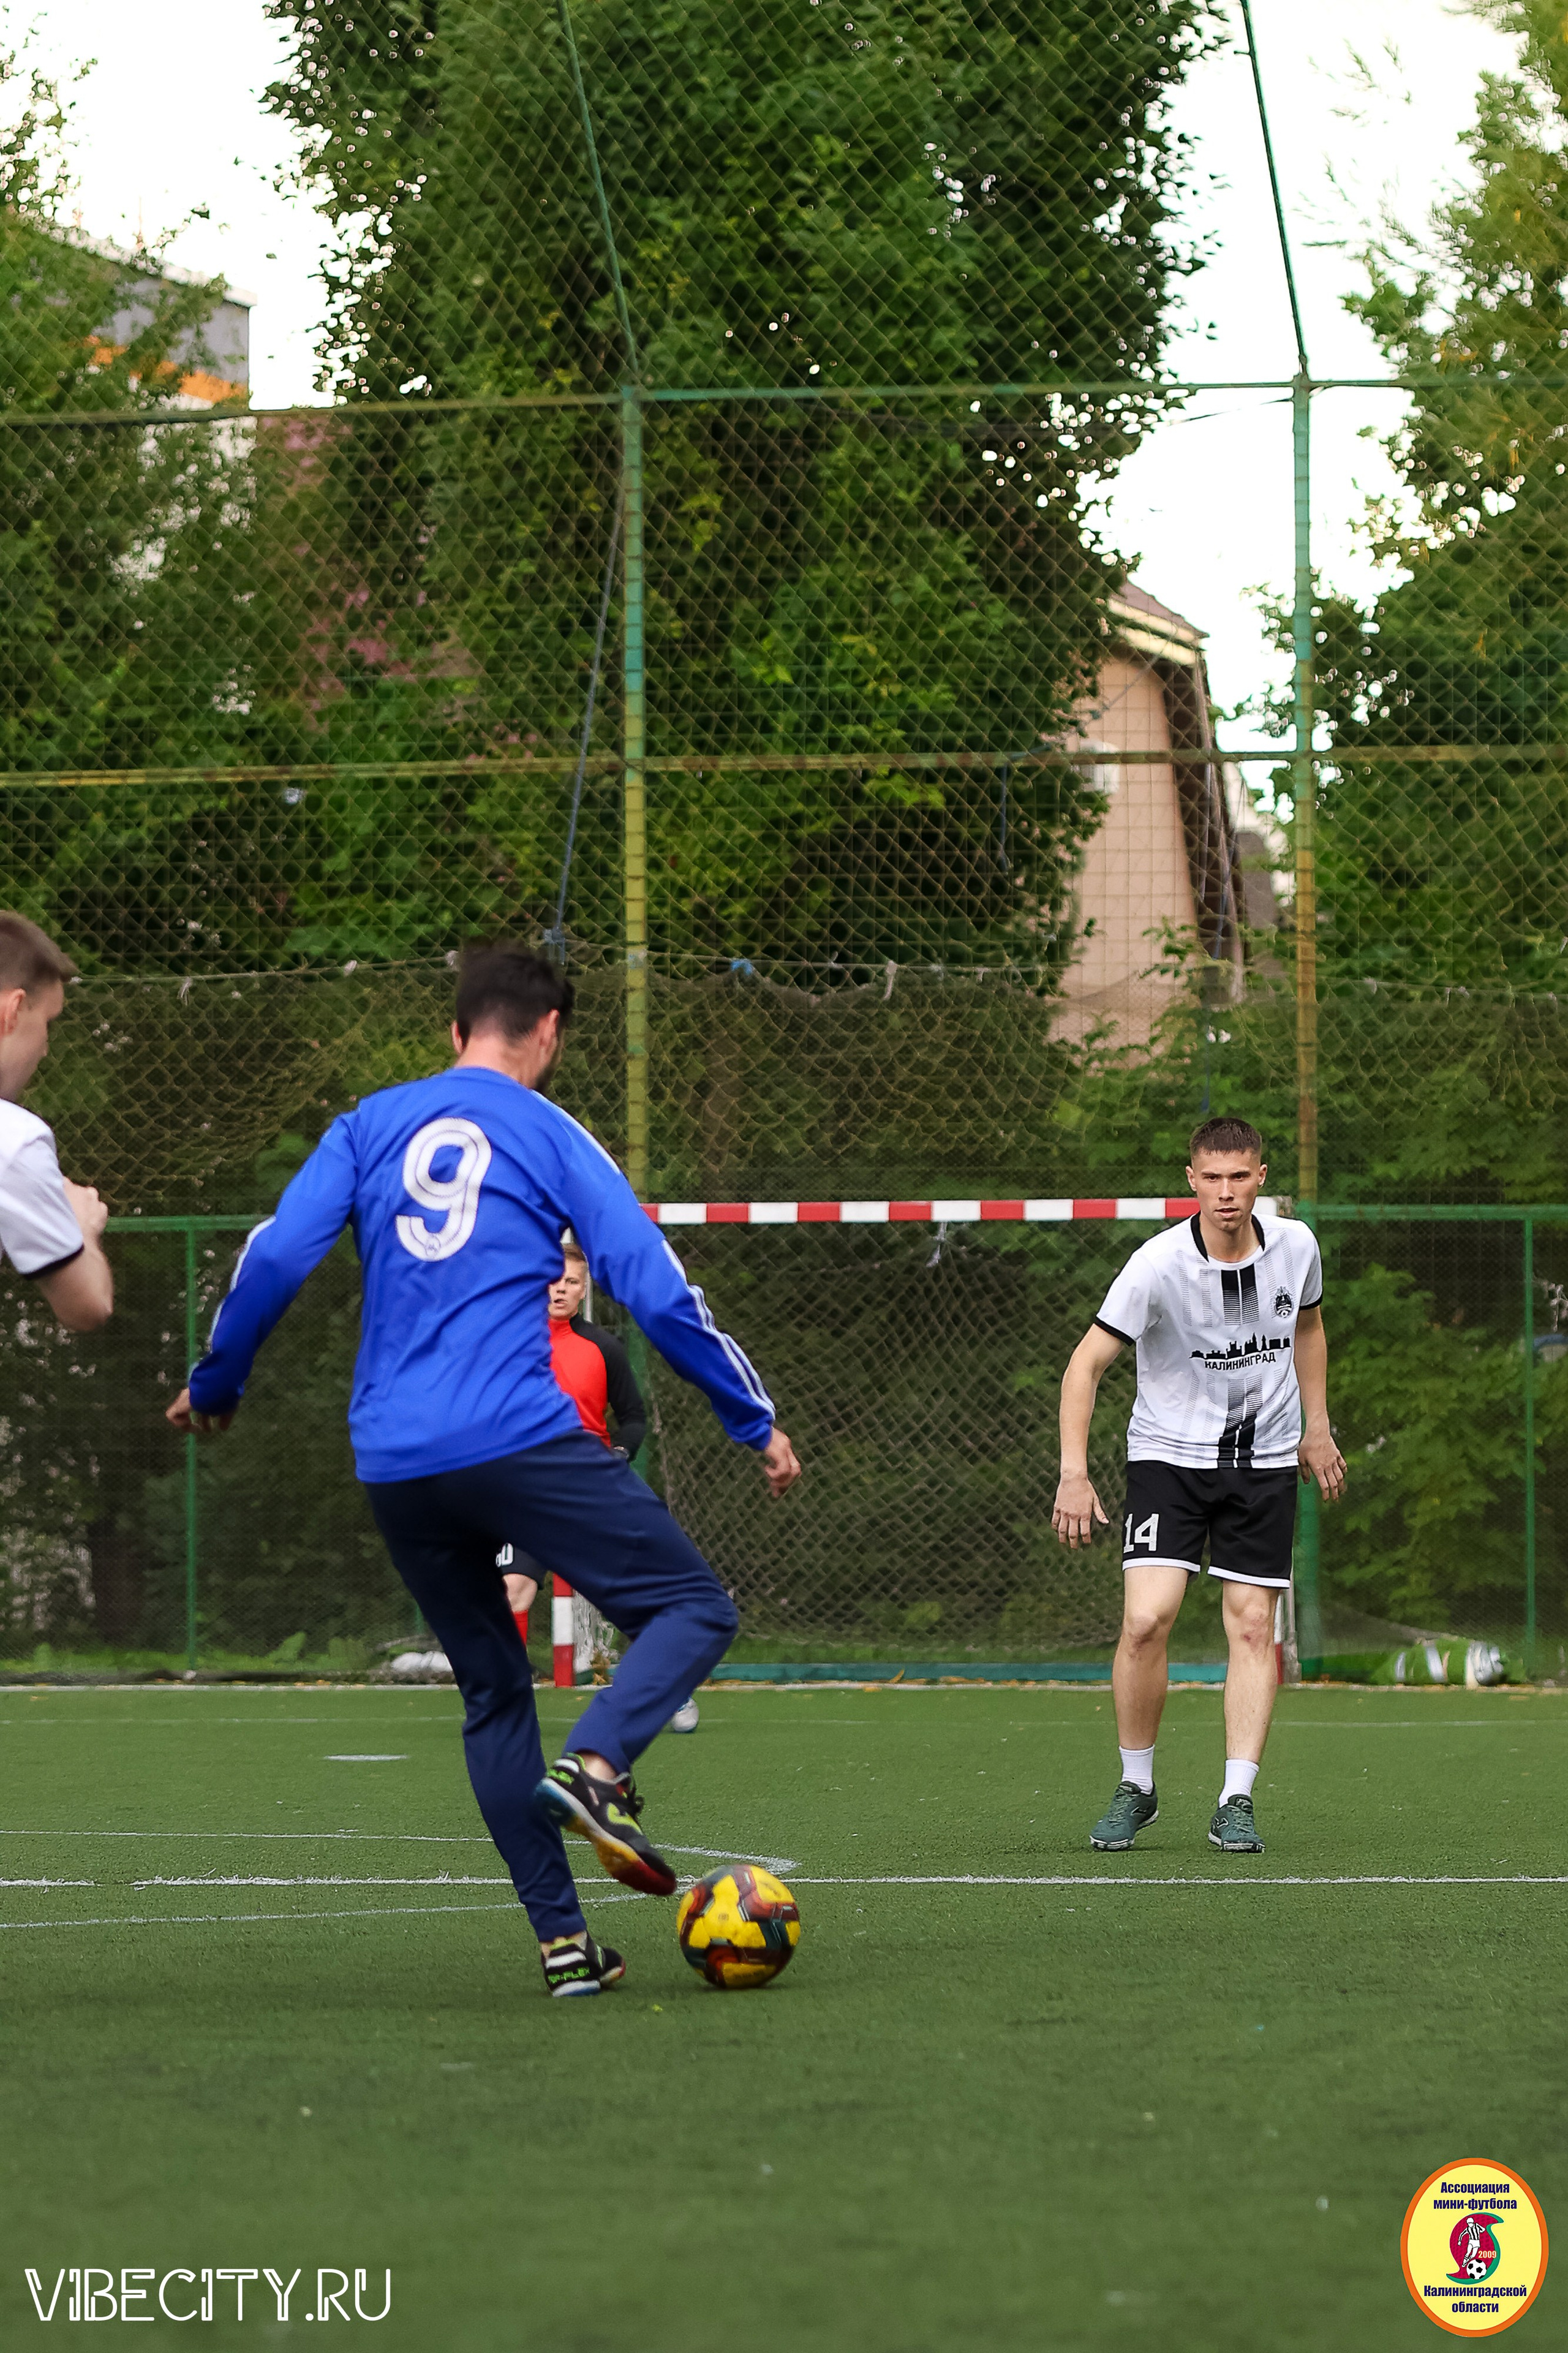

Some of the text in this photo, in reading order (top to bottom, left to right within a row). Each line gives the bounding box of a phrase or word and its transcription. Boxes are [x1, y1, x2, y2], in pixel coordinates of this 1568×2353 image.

[395, 1117, 492, 1262] 9
[1204, 1352, 1276, 1371] КАЛИНИНГРАД
[1123, 1513, 1159, 1554] 14
